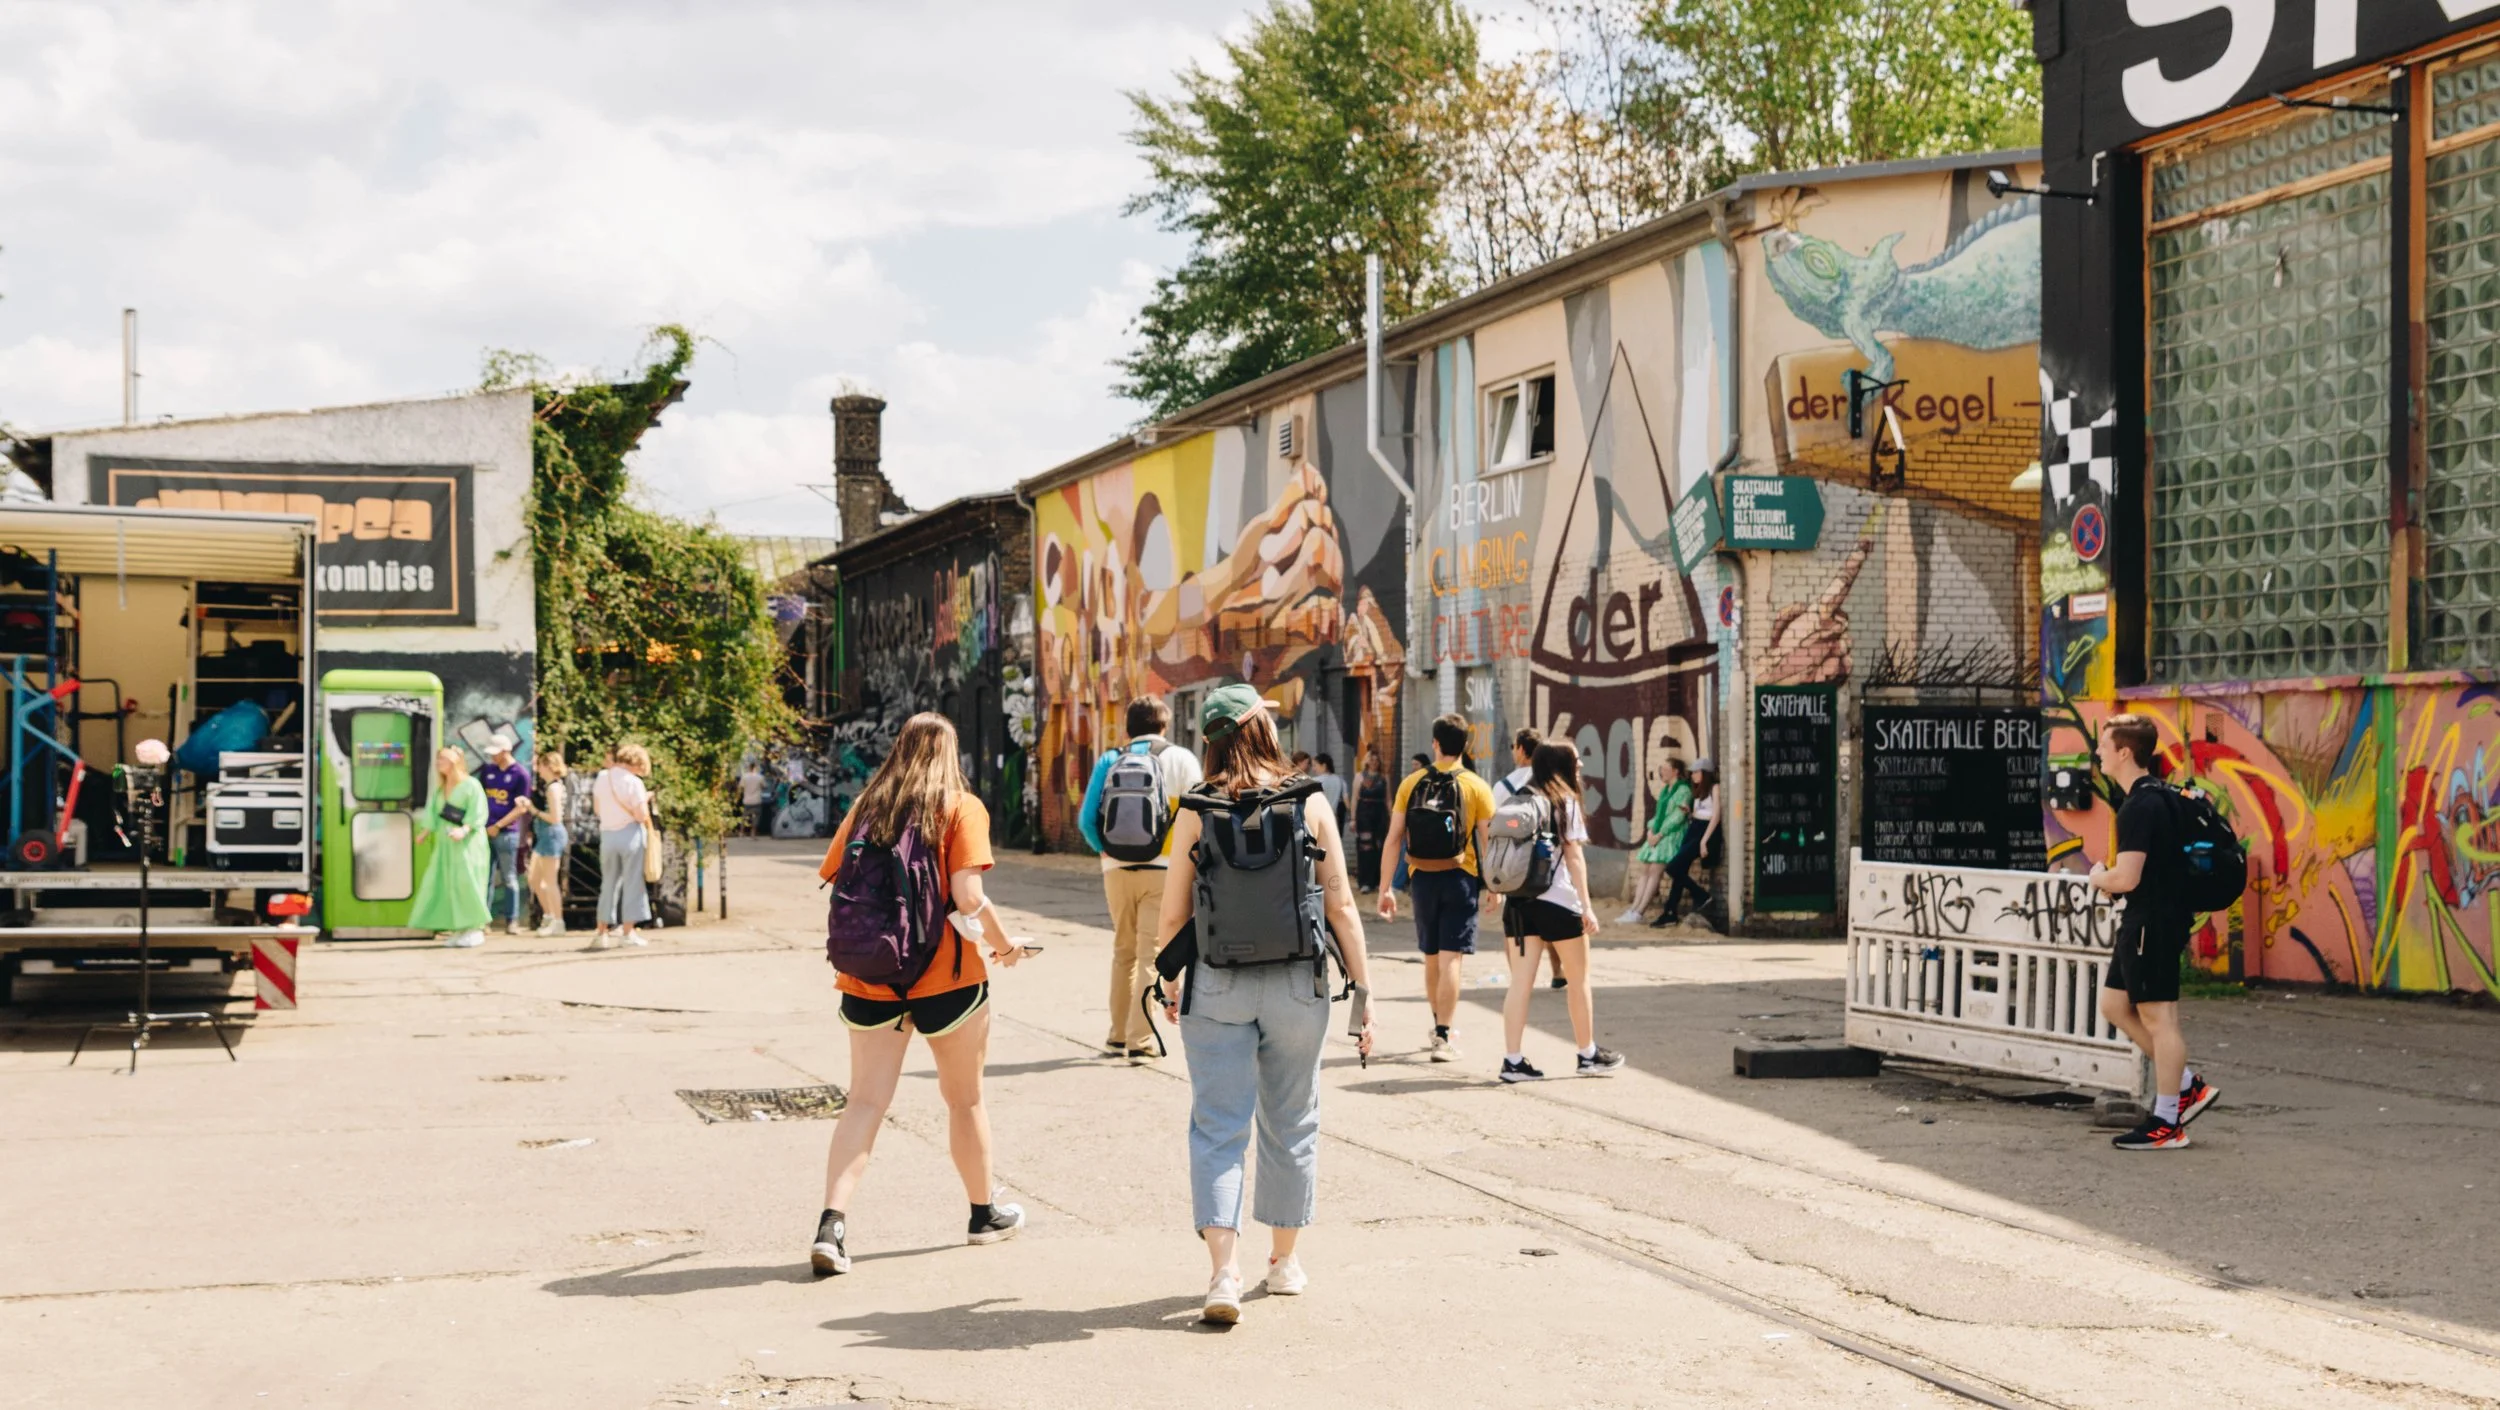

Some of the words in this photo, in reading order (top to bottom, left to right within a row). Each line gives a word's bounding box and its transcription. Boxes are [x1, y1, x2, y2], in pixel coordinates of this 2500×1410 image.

[1787, 376, 1848, 421] der
[1881, 376, 1995, 435] Kegel
[1450, 472, 1523, 531] BERLIN
[1732, 480, 1784, 496] SKATEHALLE
[1732, 495, 1756, 510] CAFE
[1733, 524, 1796, 541] BOULDERHALLE
[1429, 530, 1528, 598] CLIMBING
[1431, 603, 1530, 664] CULTURE
[1568, 568, 1663, 662] der
[1760, 694, 1827, 717] SKATEHALLE
[1874, 718, 1986, 750] SKATEHALLE
[1993, 719, 2041, 749] BERL
